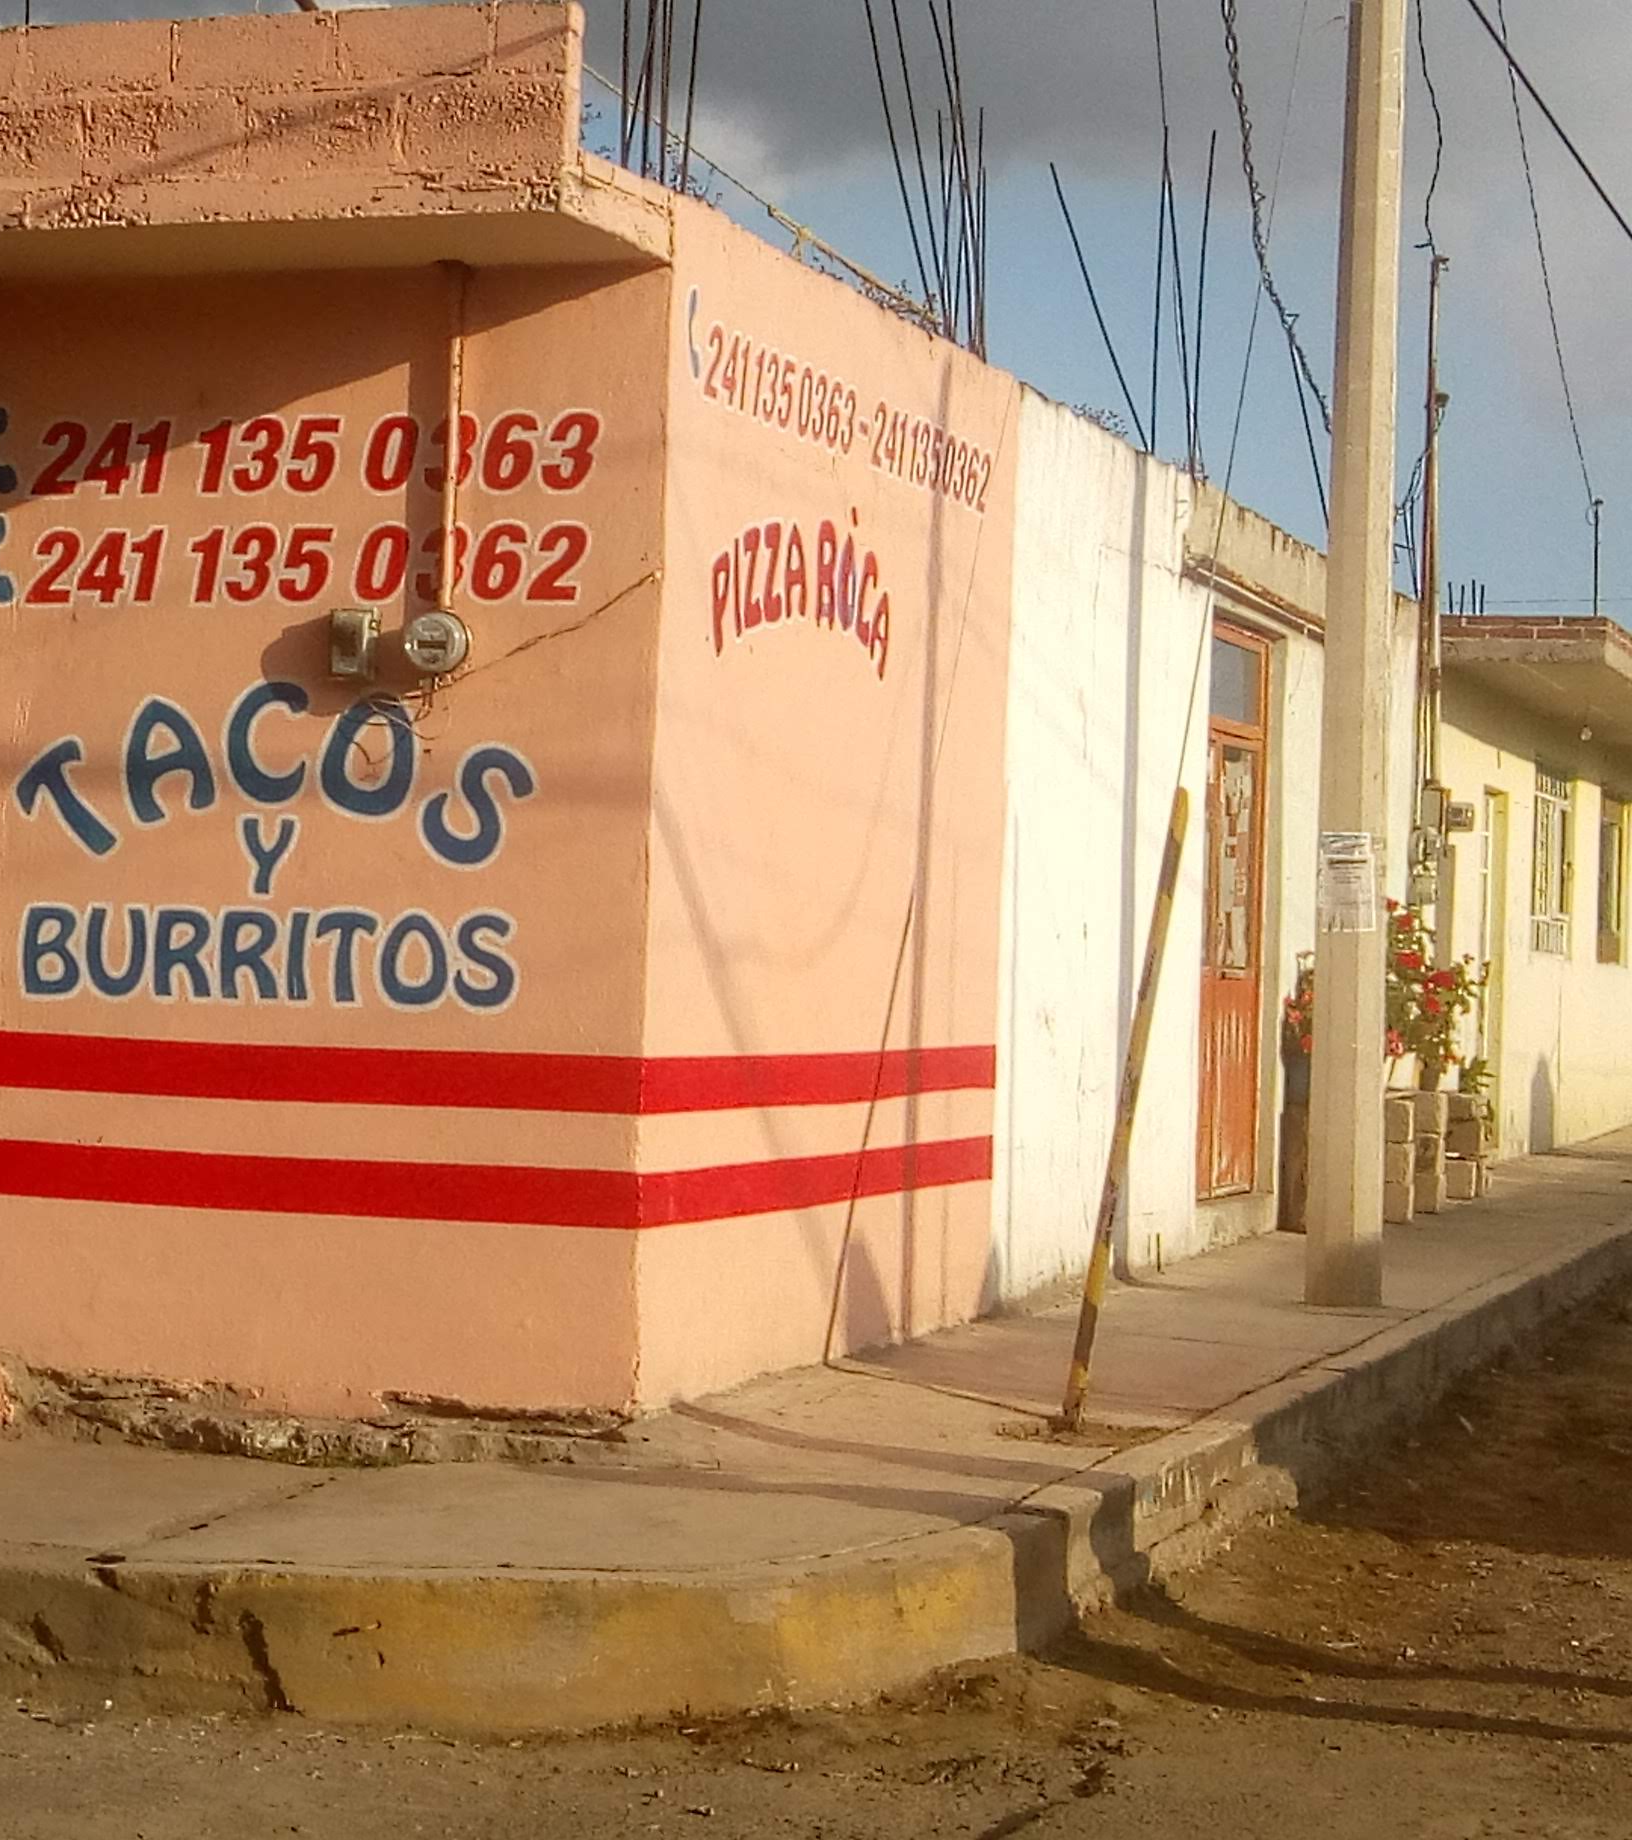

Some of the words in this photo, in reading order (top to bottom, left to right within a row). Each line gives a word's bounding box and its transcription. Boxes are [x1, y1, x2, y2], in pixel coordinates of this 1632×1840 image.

[28, 418, 173, 498] 241
[196, 416, 343, 496] 135
[361, 409, 603, 495] 0363
[22, 523, 167, 606] 241
[188, 522, 336, 606] 135
[352, 518, 591, 606] 0362
[711, 520, 809, 658] PIZZA
[14, 678, 537, 866] TACOS
[241, 815, 299, 897] Y
[22, 904, 518, 1011] BURRITOS
